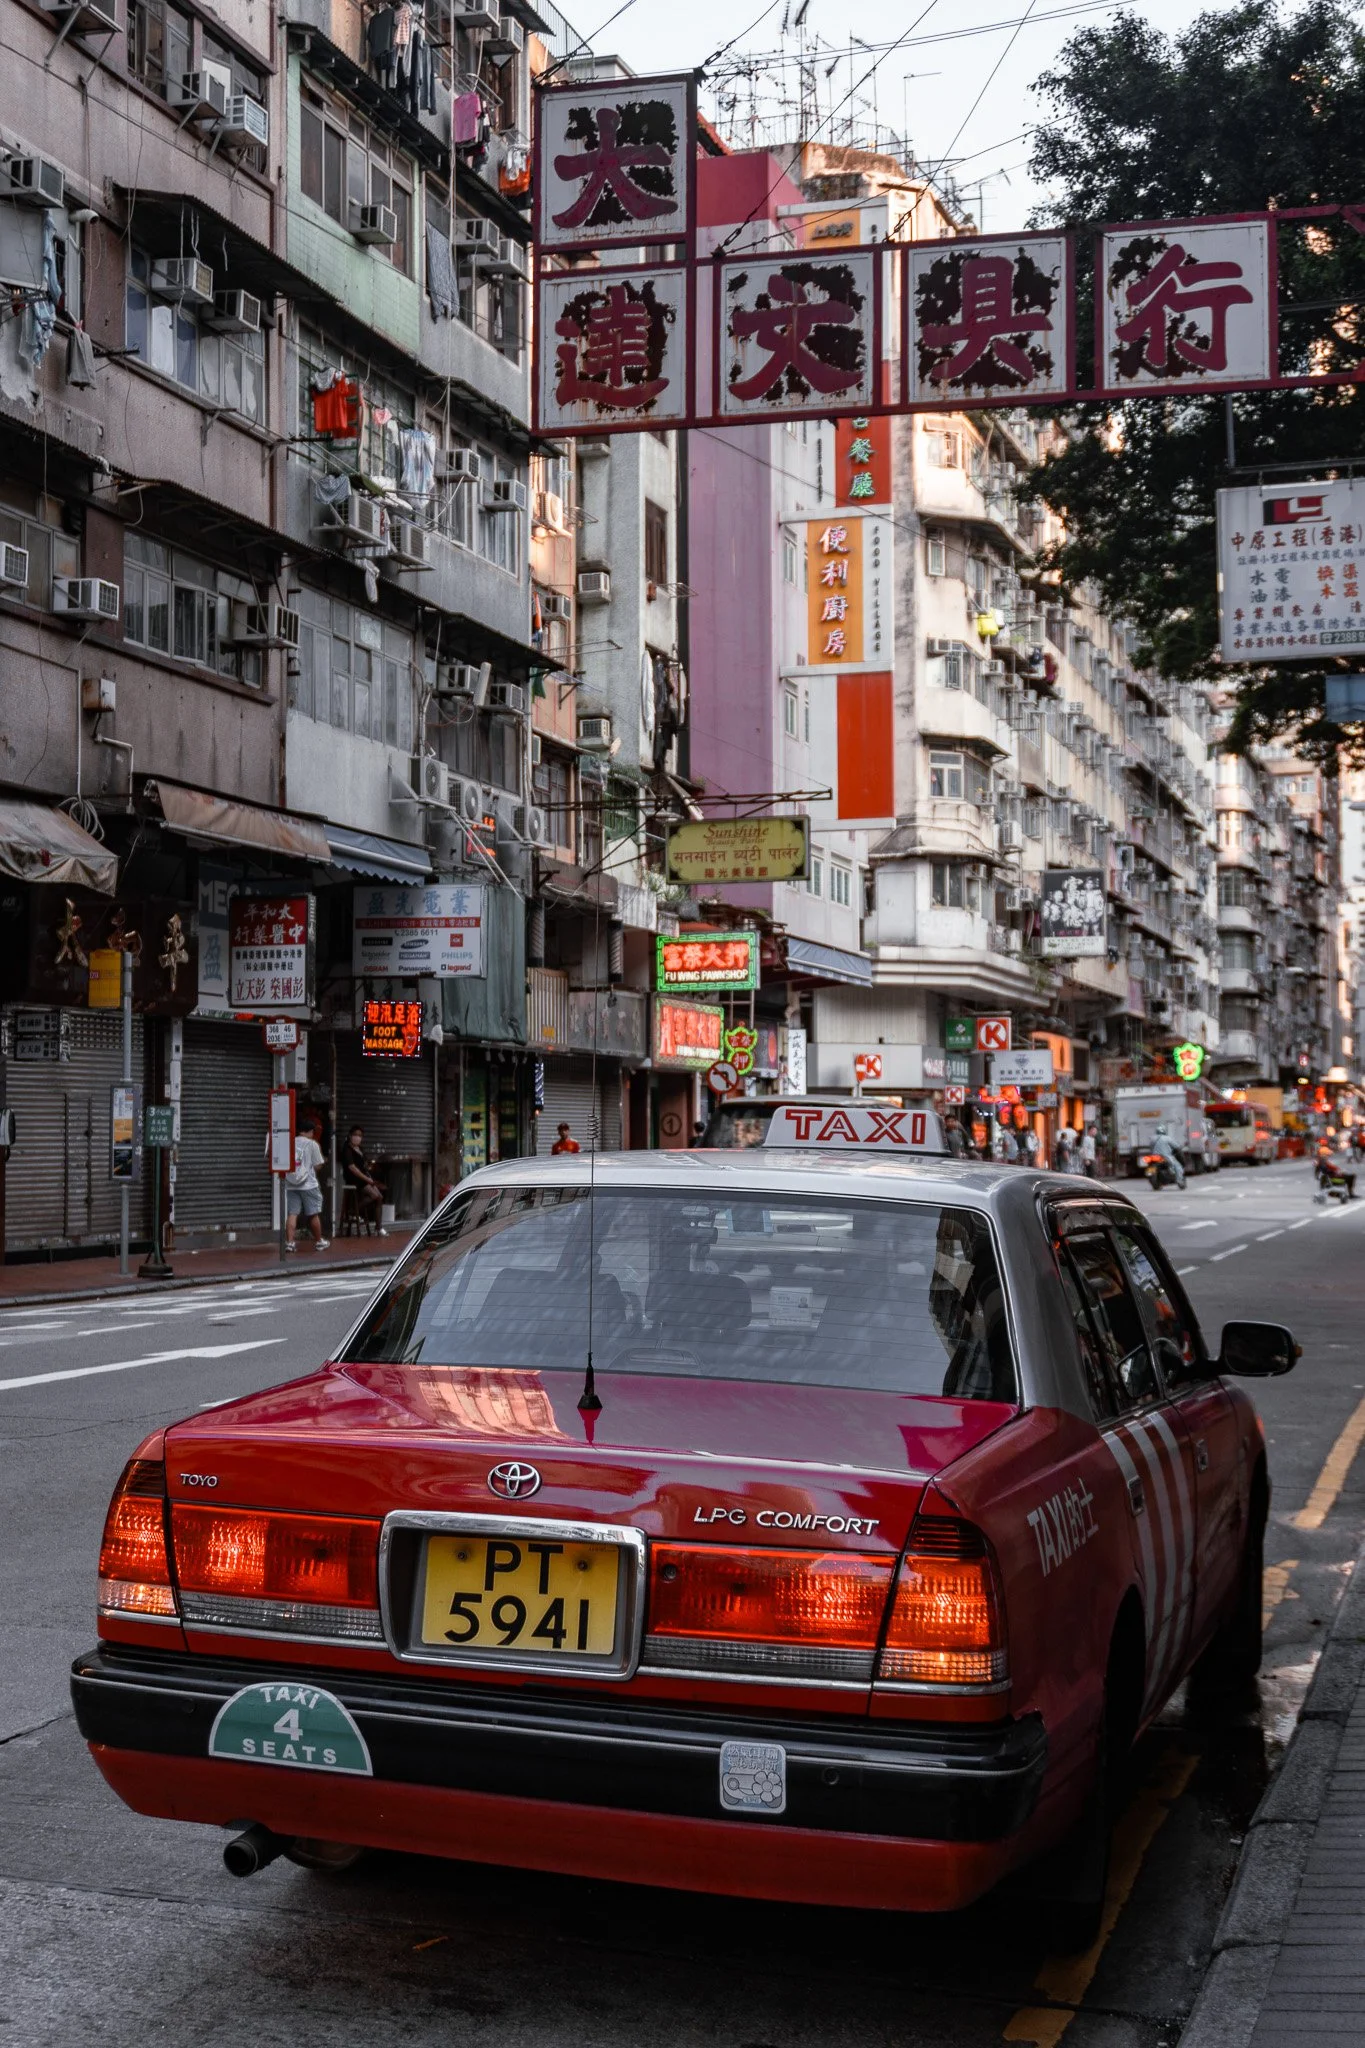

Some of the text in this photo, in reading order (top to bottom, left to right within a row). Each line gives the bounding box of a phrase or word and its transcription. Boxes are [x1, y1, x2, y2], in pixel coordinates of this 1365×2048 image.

[703, 823, 769, 839] Sunshine
[398, 964, 432, 972] Panasonic
[447, 963, 472, 972] legrand
[665, 969, 748, 981] FU WING PAWNSHOP
[373, 1026, 397, 1036] FOOT
[365, 1038, 403, 1049] MASSAGE
[785, 1109, 926, 1144] TAXI
[180, 1473, 218, 1488] TOYO
[693, 1506, 881, 1535] LPG COMFORT
[484, 1541, 563, 1595] PT
[444, 1592, 589, 1650] 5941
[259, 1686, 321, 1709] TAXI
[274, 1708, 303, 1741] 4
[242, 1738, 337, 1764] SEATS
